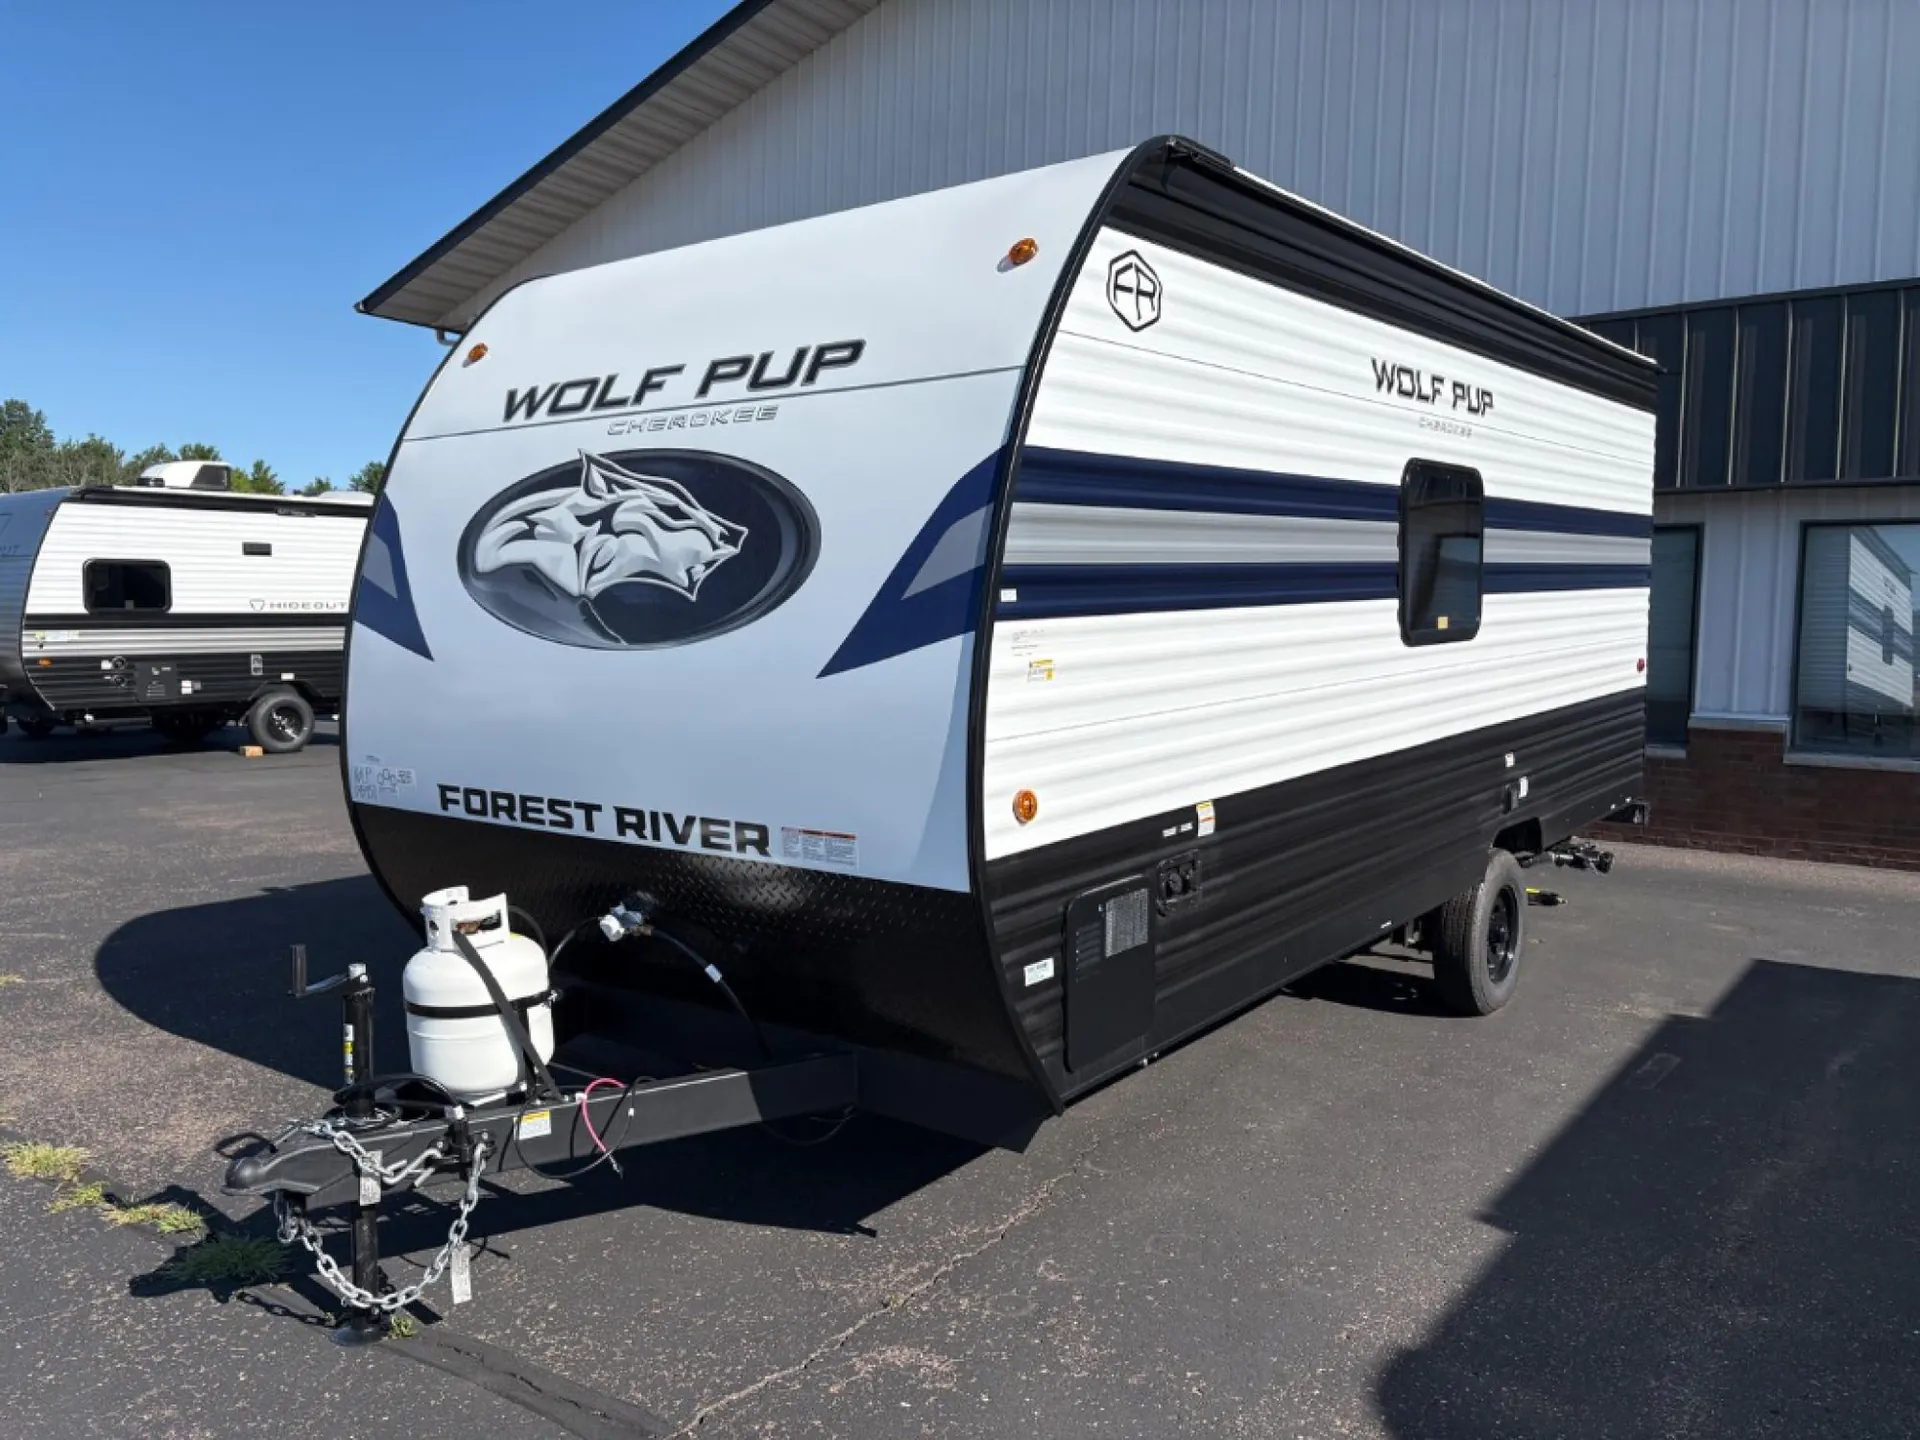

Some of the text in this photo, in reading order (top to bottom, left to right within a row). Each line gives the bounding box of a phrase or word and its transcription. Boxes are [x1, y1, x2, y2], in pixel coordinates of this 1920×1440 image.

[502, 338, 867, 422] WOLF PUP
[1371, 356, 1494, 416] WOLF PUP
[607, 405, 778, 435] CHEROKEE
[269, 601, 348, 611] HIDEOUT
[437, 783, 603, 833] FOREST
[612, 805, 772, 857] RIVER
